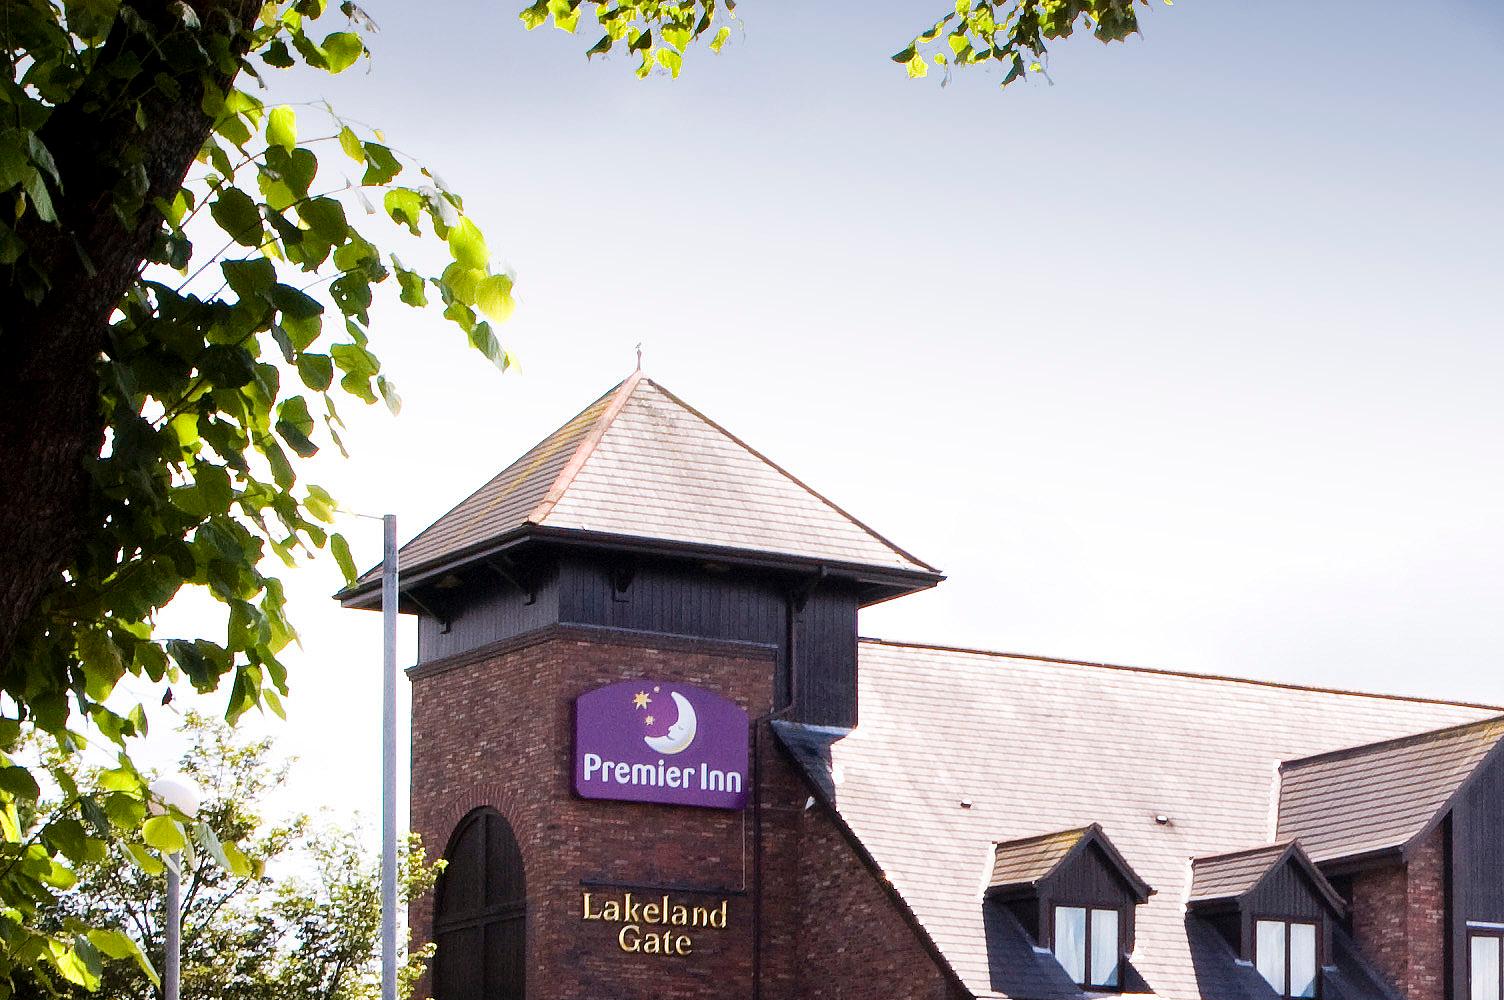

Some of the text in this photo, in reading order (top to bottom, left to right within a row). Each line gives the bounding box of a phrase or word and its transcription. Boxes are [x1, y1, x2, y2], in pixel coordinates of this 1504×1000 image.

[583, 753, 742, 793] Premier Inn
[582, 892, 728, 929] Lakeland
[618, 924, 693, 955] Gate
